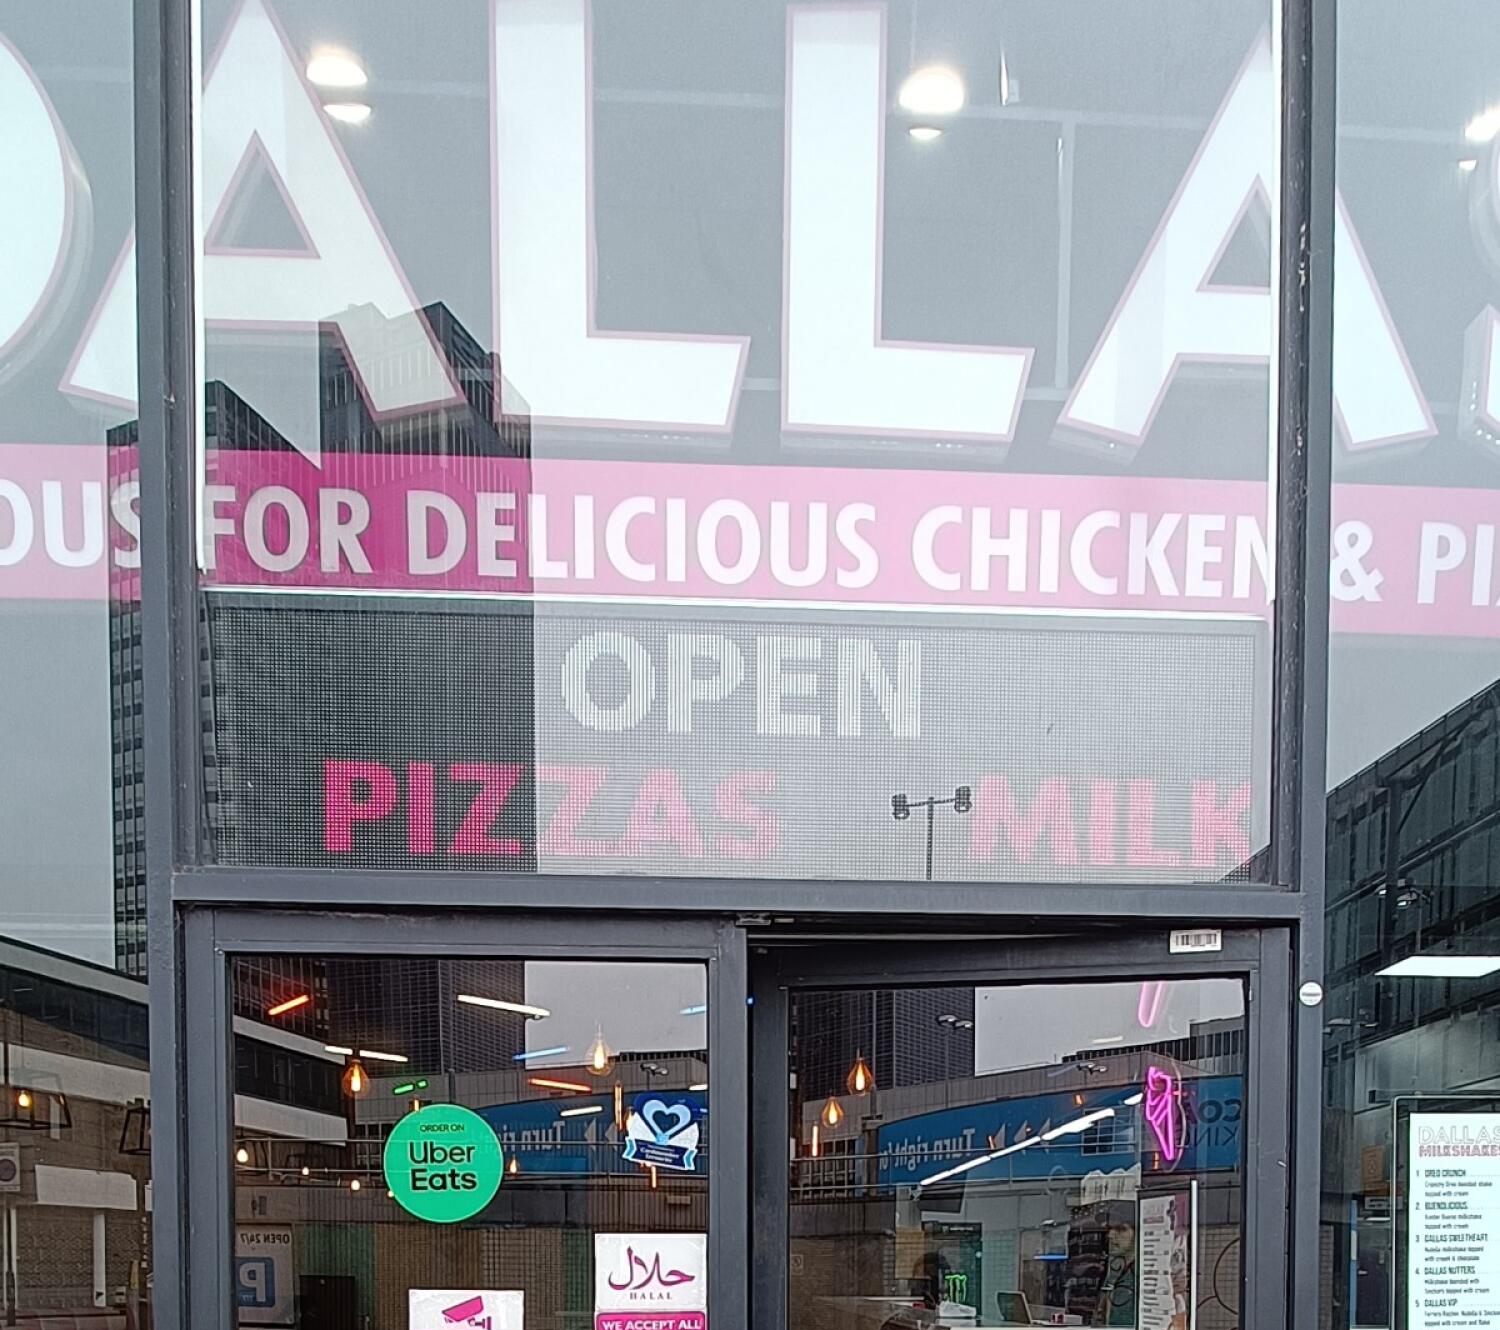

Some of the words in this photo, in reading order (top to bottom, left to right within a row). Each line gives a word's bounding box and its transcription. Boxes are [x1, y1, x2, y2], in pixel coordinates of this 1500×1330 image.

[0, 0, 1500, 452] ALLA
[203, 485, 373, 574] FOR
[406, 488, 880, 591] DELICIOUS
[1330, 520, 1385, 602] &
[1416, 520, 1500, 607] PI
[560, 630, 922, 738] OPEN
[322, 758, 784, 863] PIZZAS
[969, 773, 1251, 868] MILK
[419, 1124, 449, 1132] ORDER
[450, 1123, 465, 1131] ON
[409, 1141, 476, 1164] Uber
[1419, 1144, 1500, 1157] MILKSHAKE
[410, 1168, 477, 1191] Eats
[608, 1245, 696, 1291] حلال
[629, 1291, 673, 1300] HALAL
[601, 1320, 623, 1330] WE
[624, 1319, 675, 1330] ACCEPT
[678, 1319, 702, 1330] ALL
